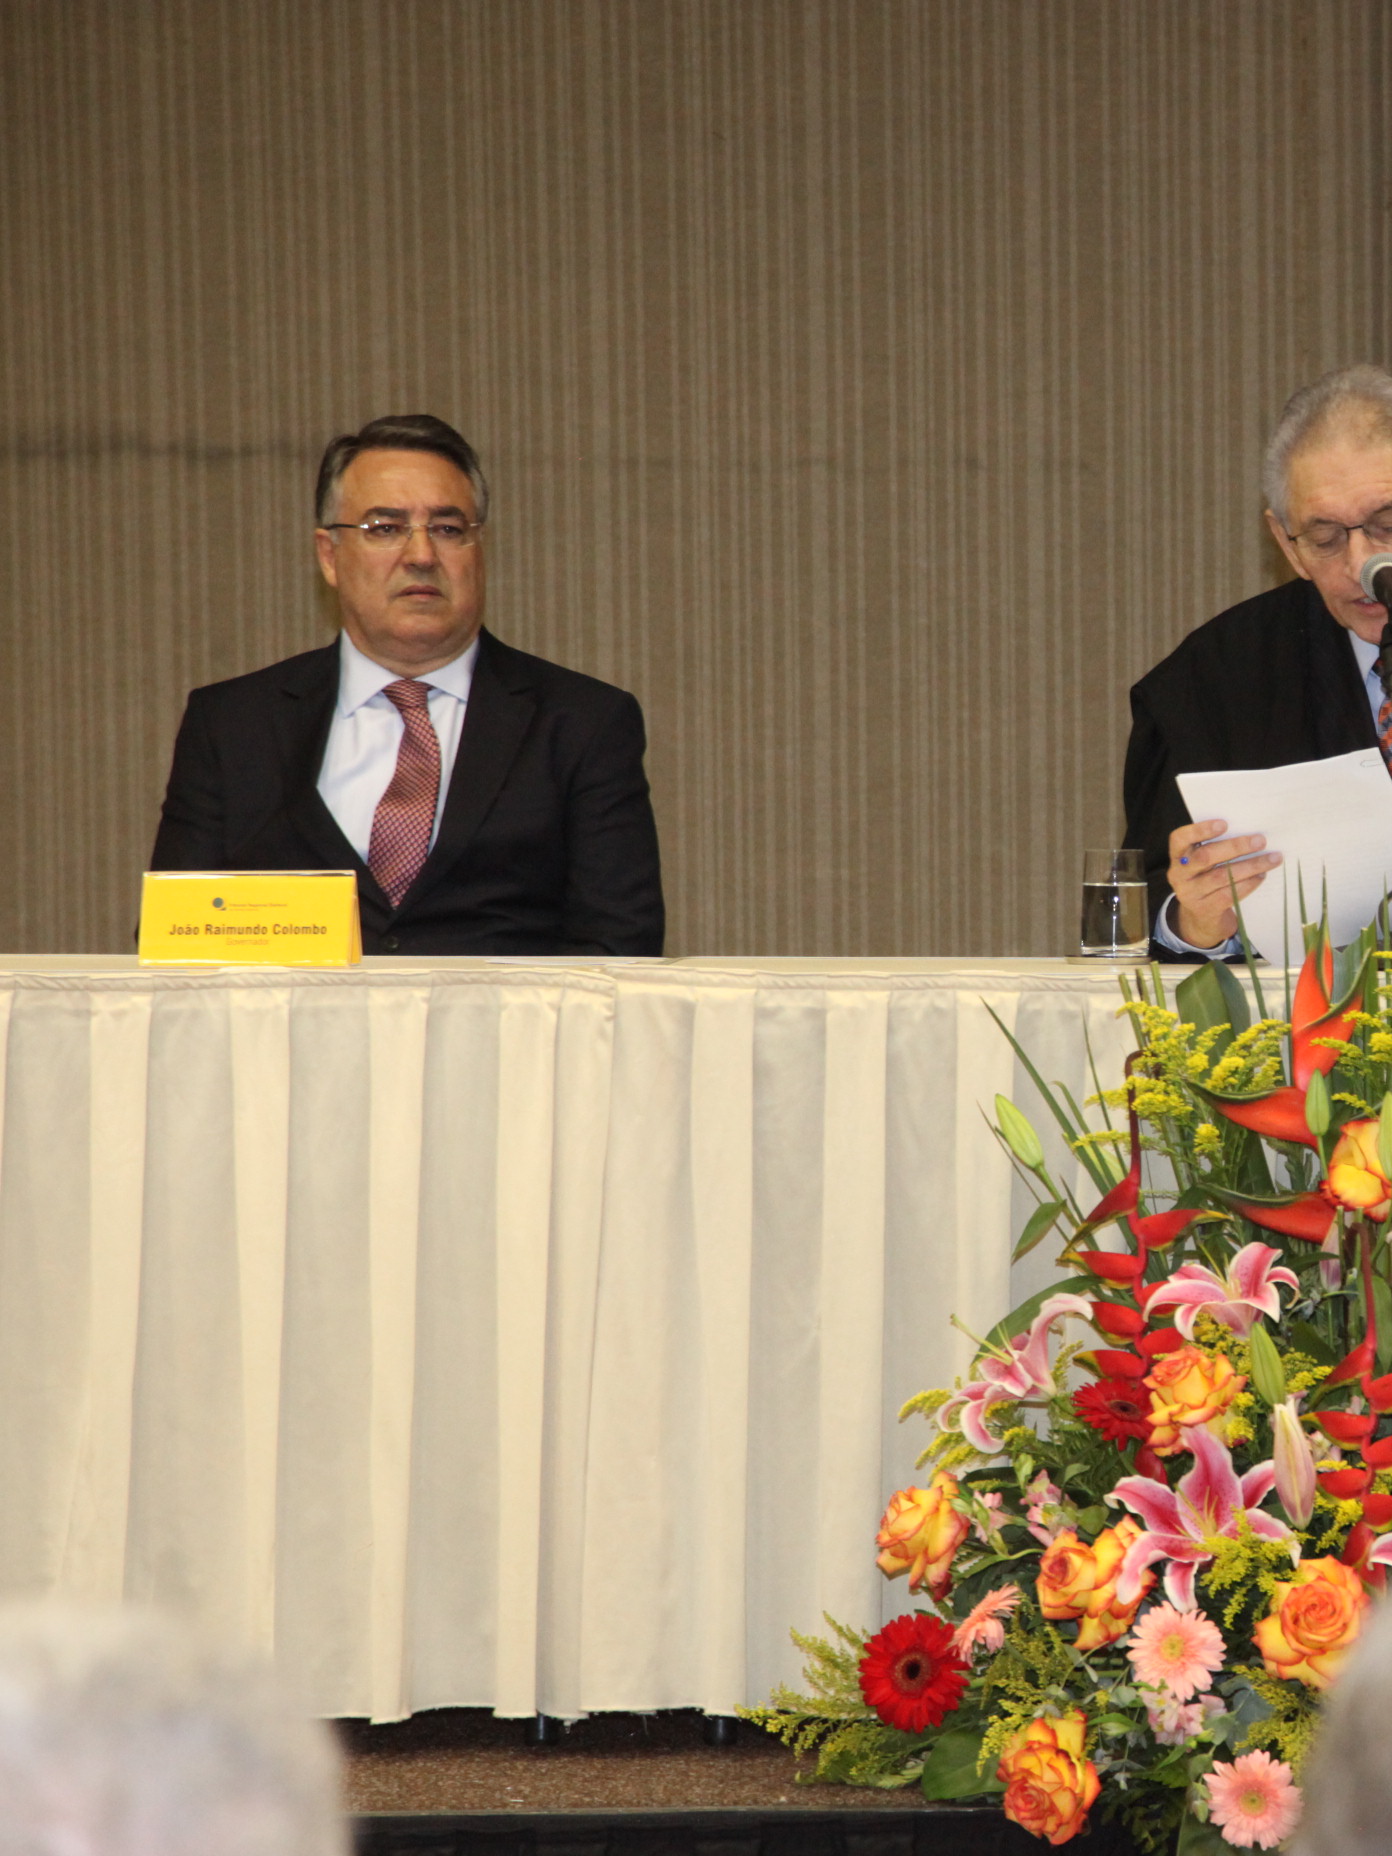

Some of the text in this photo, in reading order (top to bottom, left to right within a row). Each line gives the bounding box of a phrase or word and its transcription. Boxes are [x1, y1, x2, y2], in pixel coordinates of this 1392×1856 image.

[168, 923, 327, 935] João Raimundo Colombo
